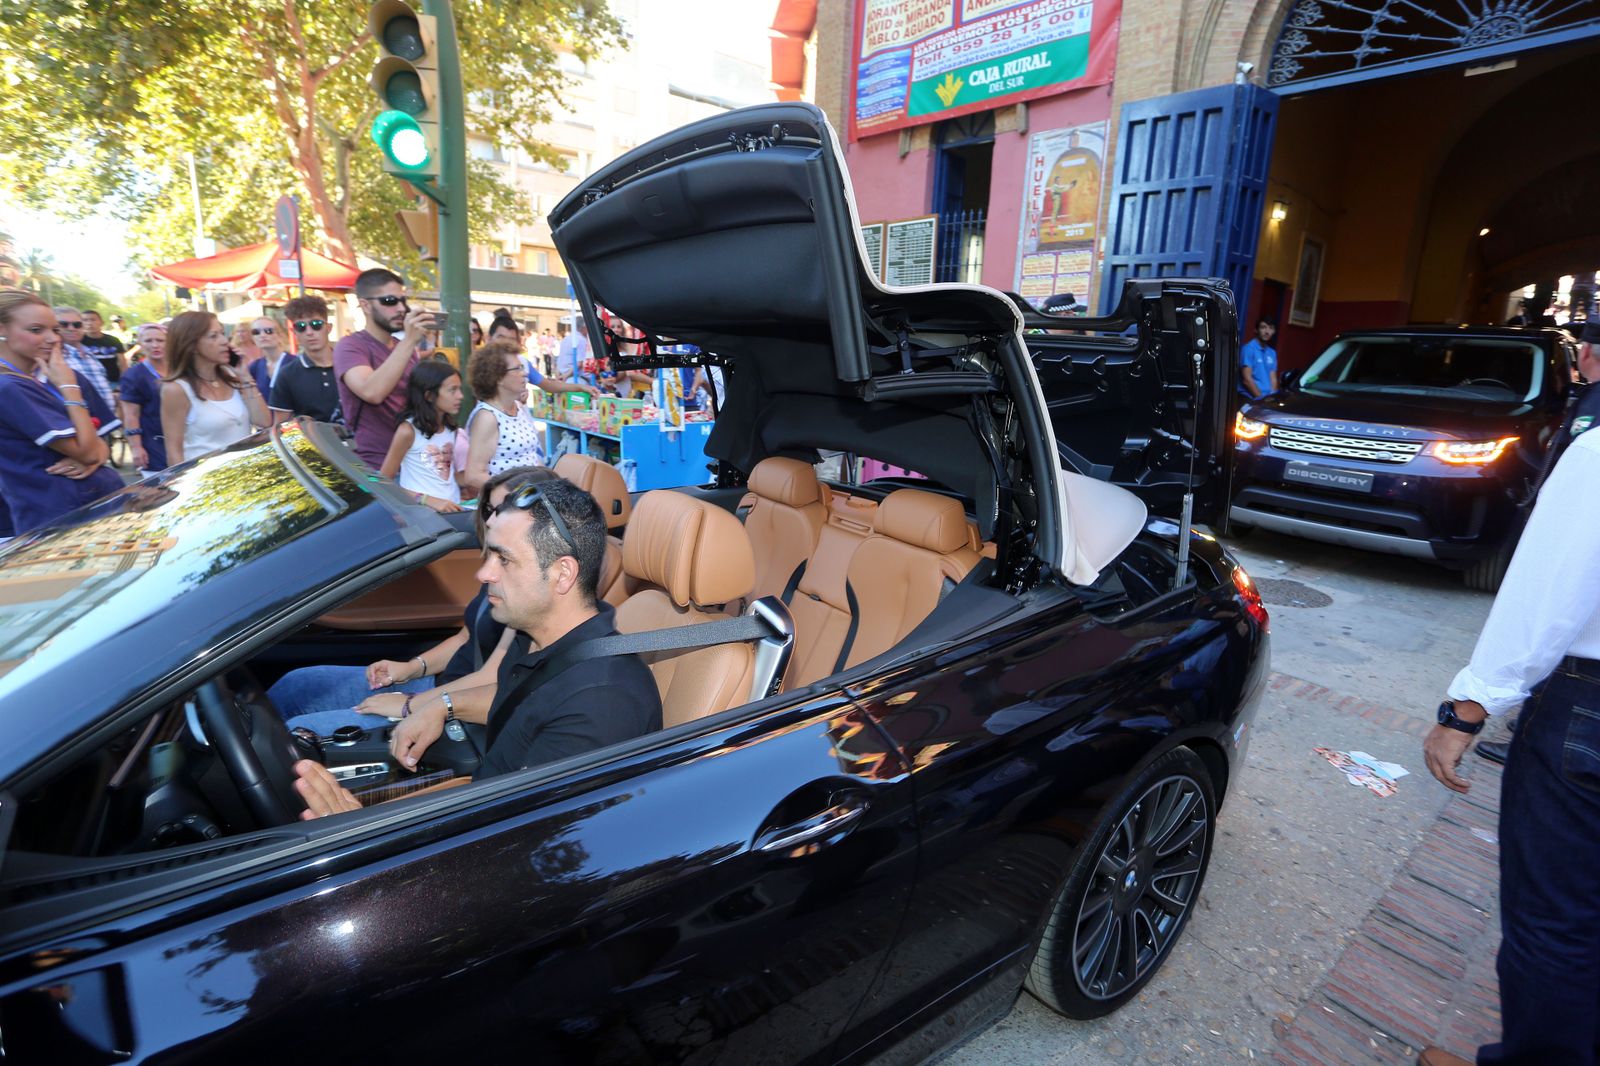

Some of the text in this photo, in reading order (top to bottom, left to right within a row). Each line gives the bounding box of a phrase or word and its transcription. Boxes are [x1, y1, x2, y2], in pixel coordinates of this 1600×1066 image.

[904, 11, 945, 38] AGUADO
[914, 23, 994, 58] MANTENEMOS
[996, 14, 1026, 31] LOS
[917, 51, 946, 67] Telf.
[952, 39, 983, 55] 959
[990, 30, 1012, 44] 28
[1021, 20, 1041, 34] 15
[1048, 10, 1074, 25] 00
[914, 29, 1073, 80] www.plazadetorosdehuelva.es
[968, 51, 1052, 87] CAJA RURAL
[989, 75, 1024, 93] DEL SUR
[1029, 156, 1045, 237] HUELVA
[1284, 419, 1411, 436] DISCOVERY
[1287, 468, 1369, 486] DISCOVERY
